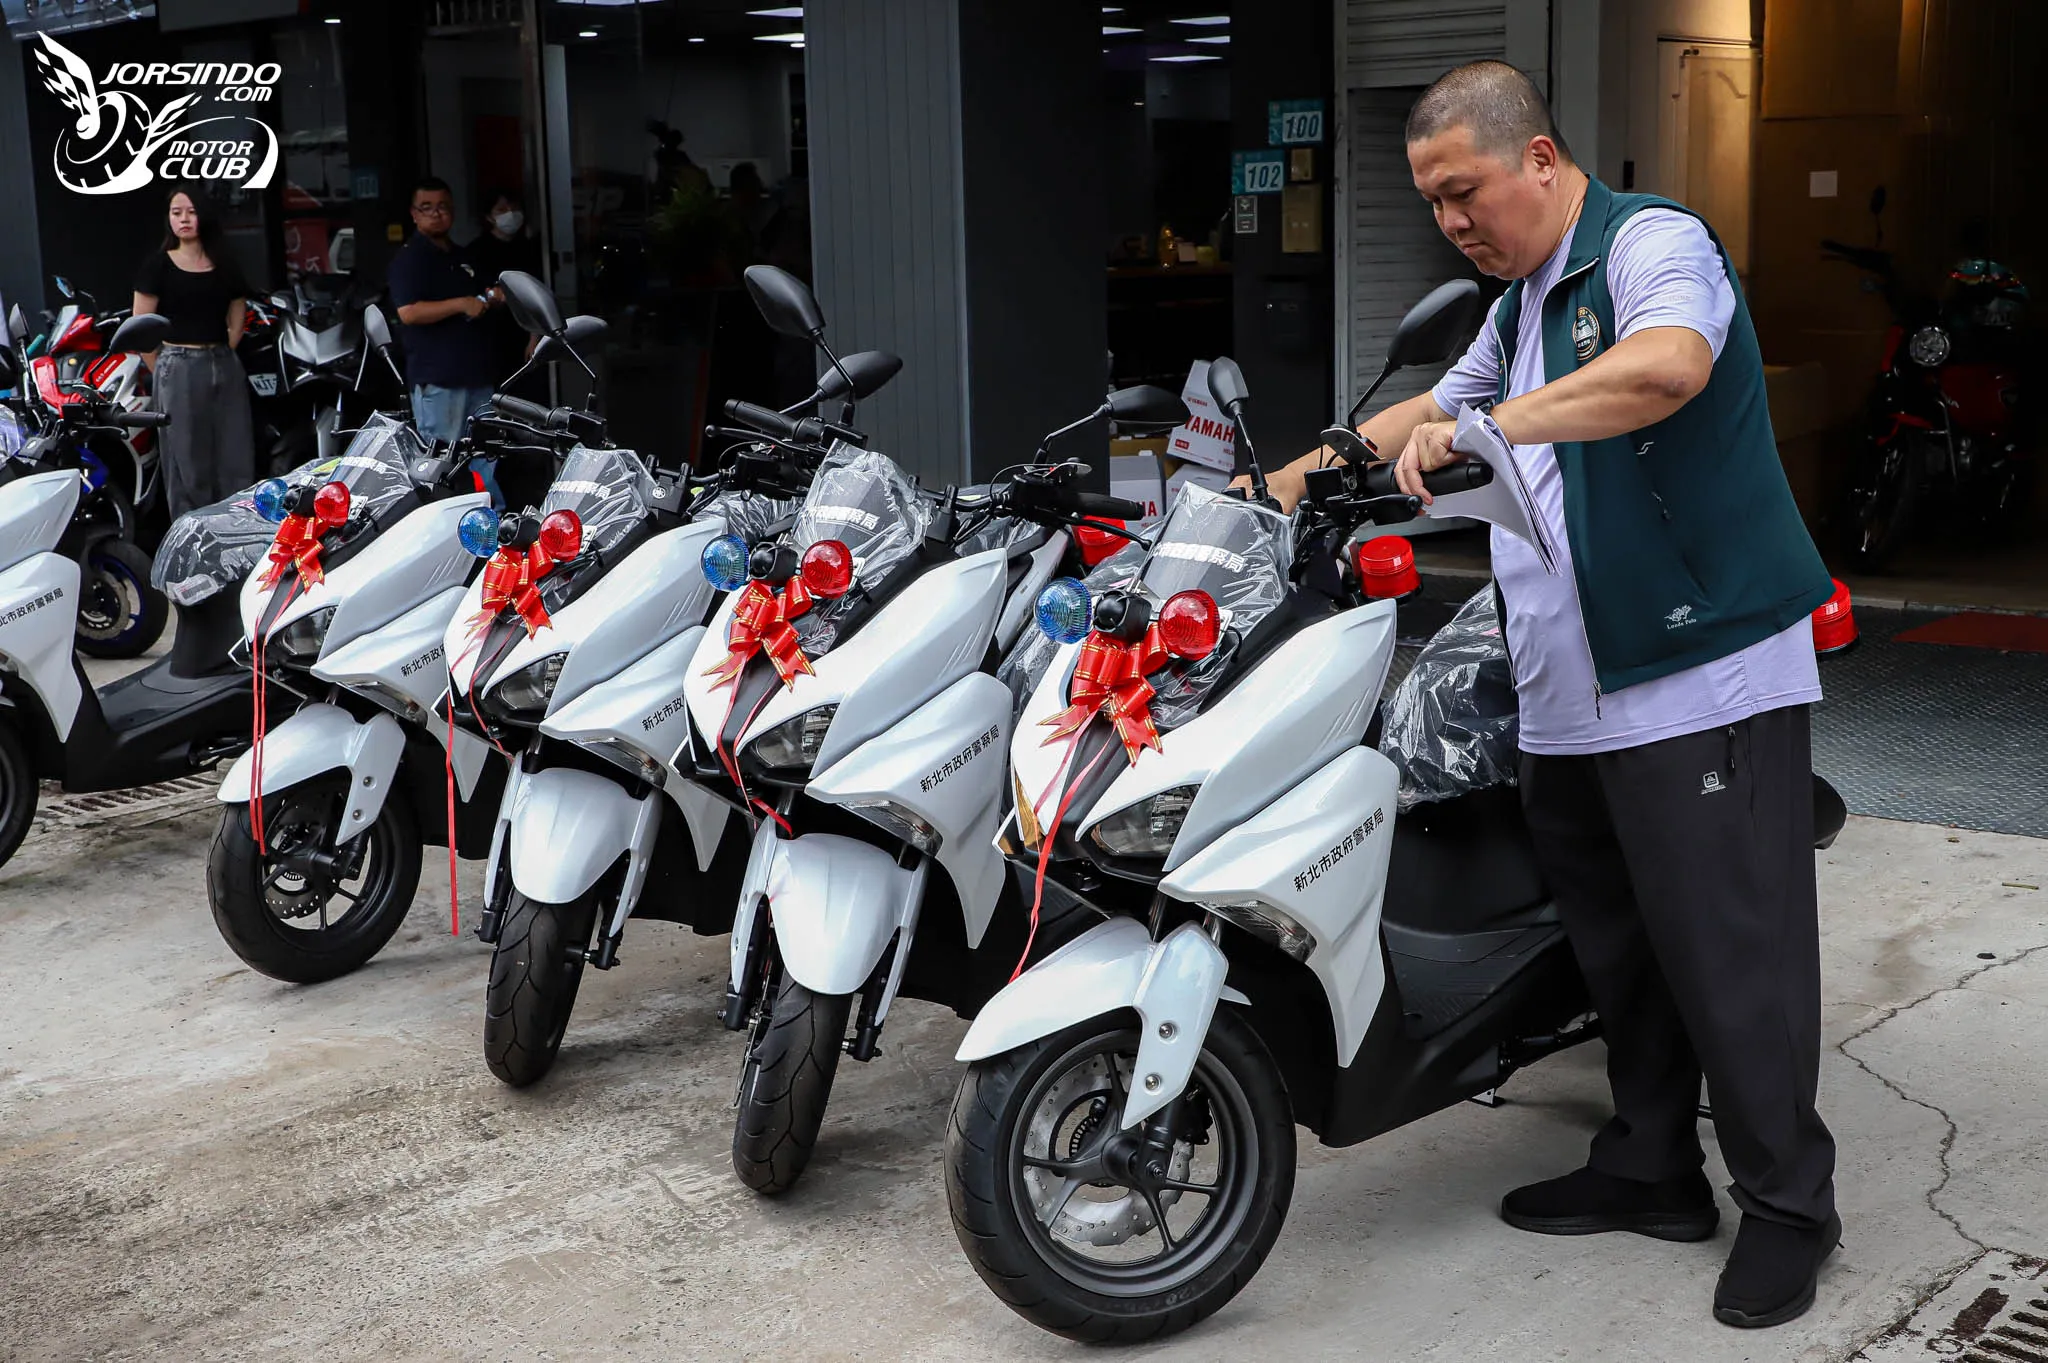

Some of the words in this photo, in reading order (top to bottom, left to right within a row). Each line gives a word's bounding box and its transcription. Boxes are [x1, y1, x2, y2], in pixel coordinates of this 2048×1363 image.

[1286, 115, 1320, 138] 100
[1248, 165, 1281, 188] 102
[1184, 414, 1235, 443] YAMAH
[641, 694, 685, 731] 新北市政
[919, 724, 1000, 793] 新北市政府警察局
[1293, 807, 1384, 892] 新北市政府警察局
